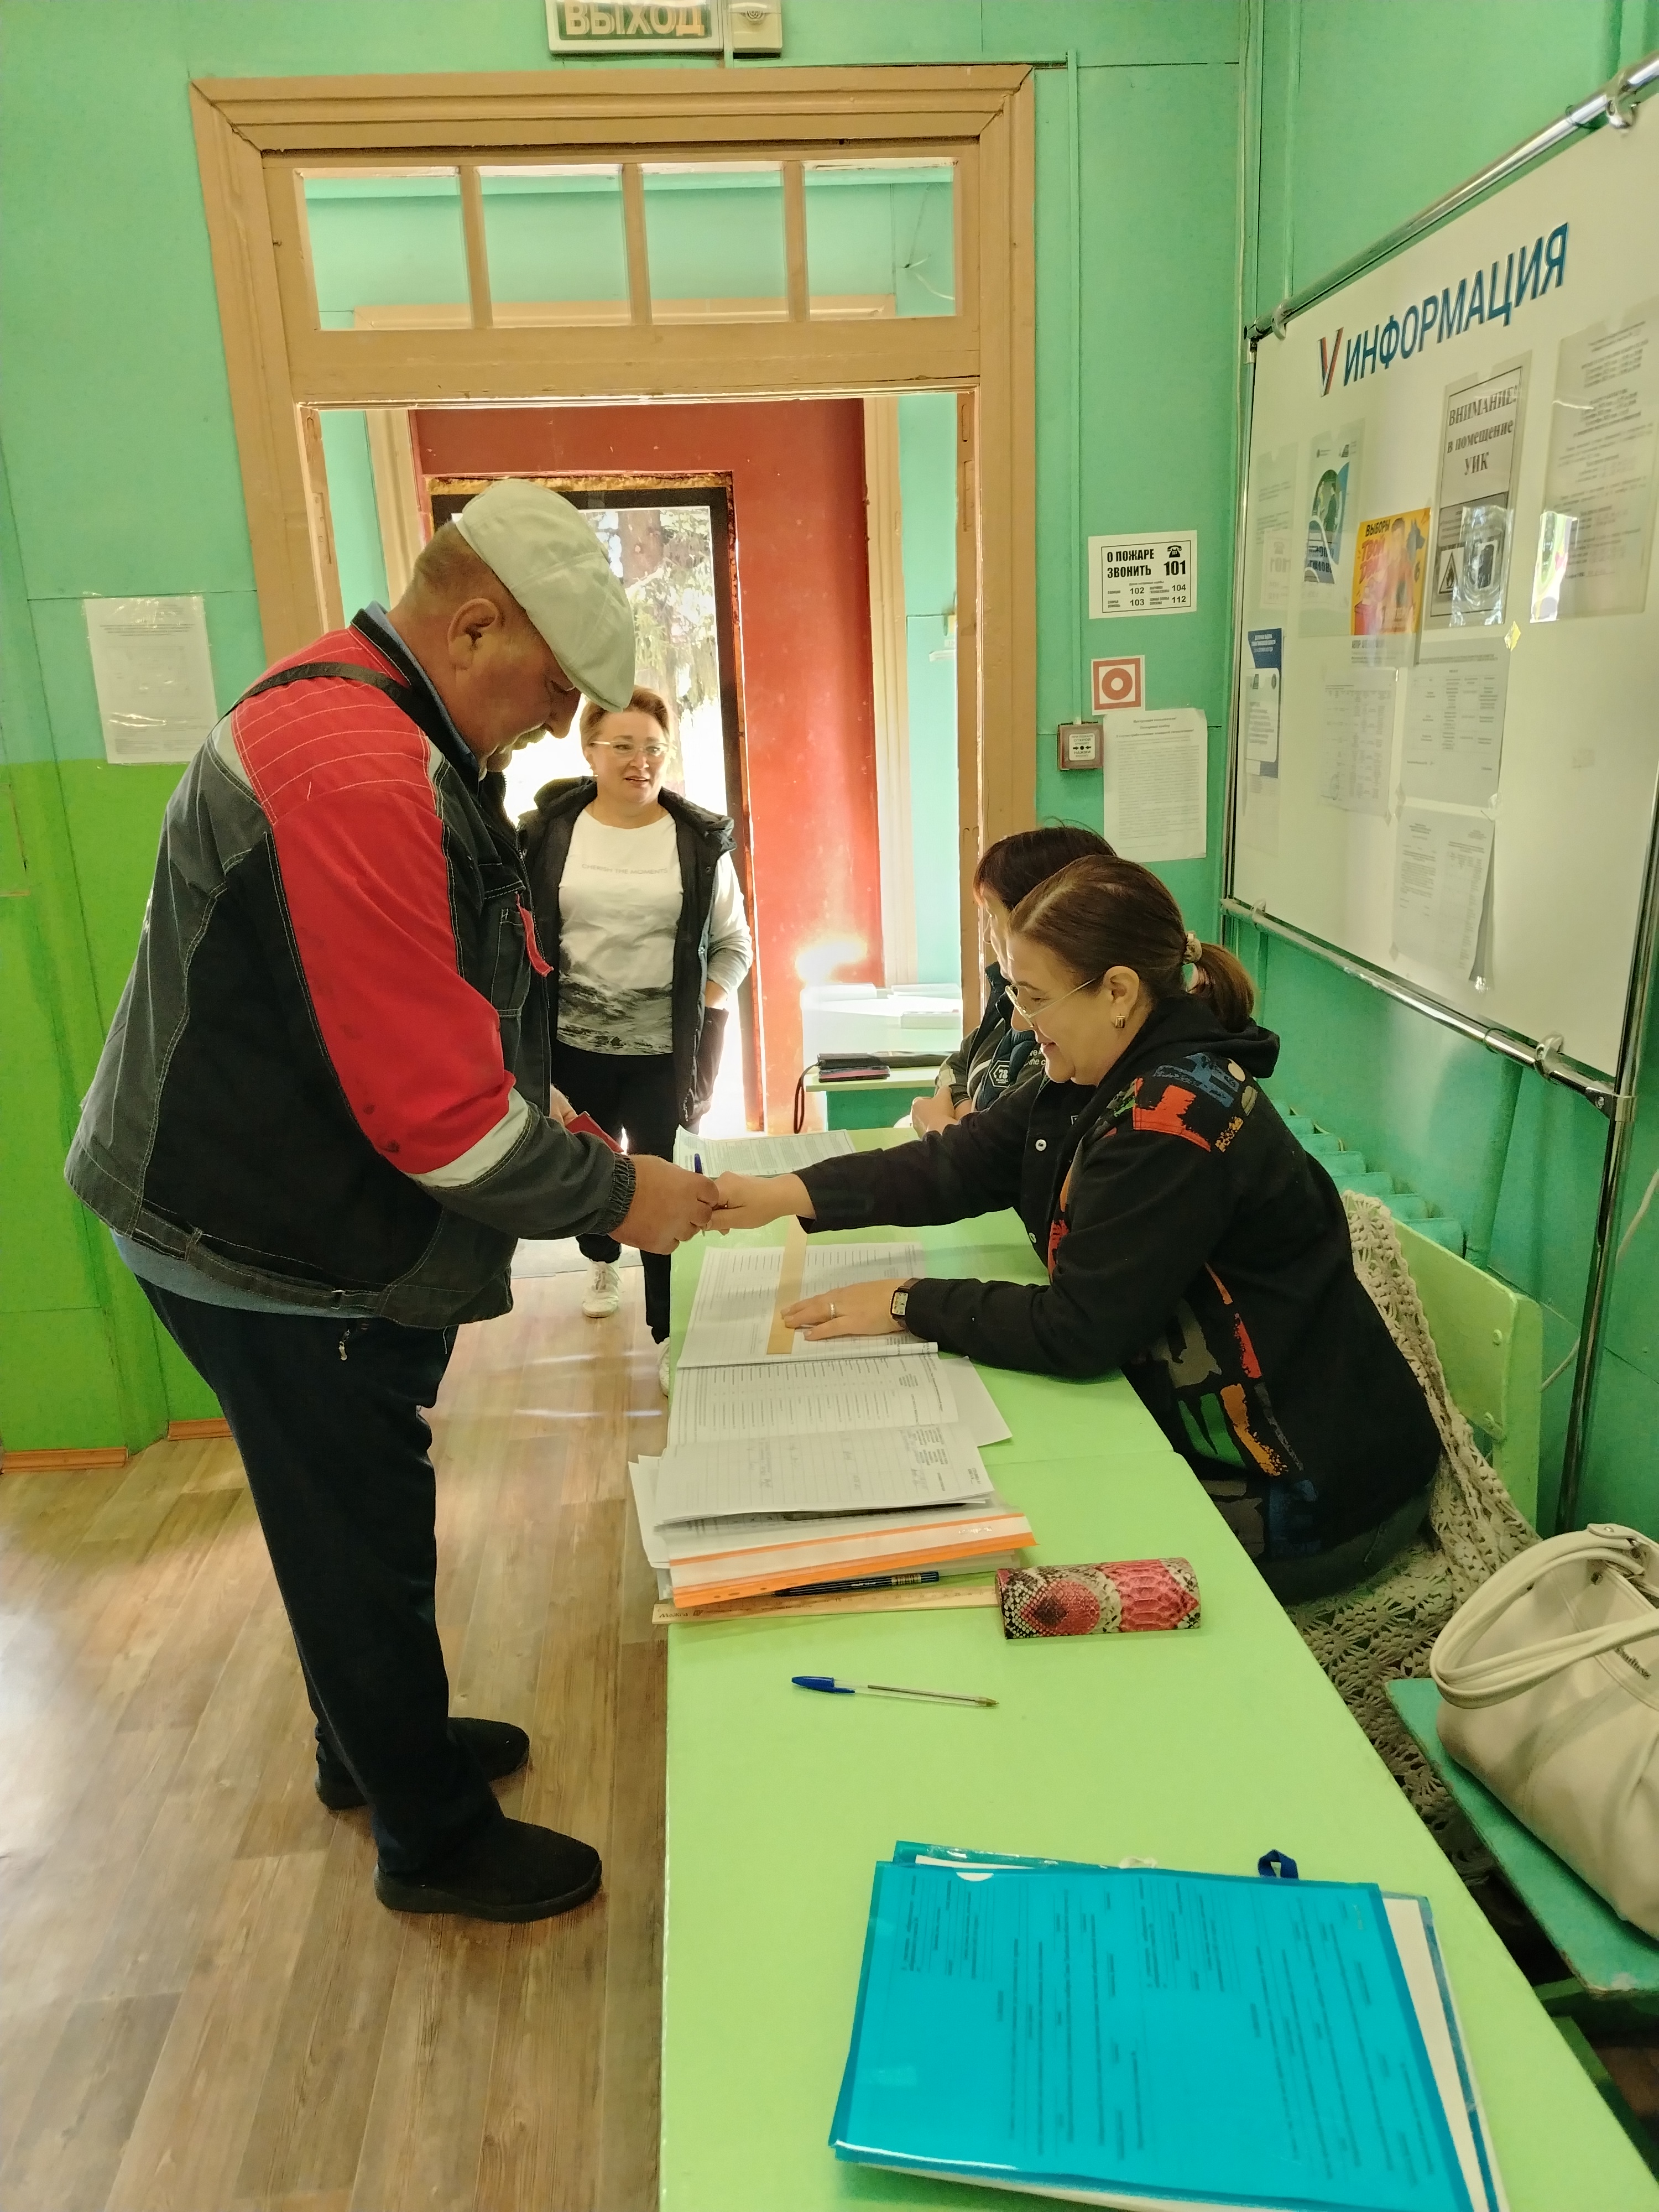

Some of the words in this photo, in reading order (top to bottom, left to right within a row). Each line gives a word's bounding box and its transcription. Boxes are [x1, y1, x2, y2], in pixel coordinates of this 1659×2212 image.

[564, 0, 705, 36] ВЫХОД
[1343, 222, 1568, 387] ИНФОРМАЦИЯ
[1448, 385, 1518, 426] ВНИМАНИЕ!
[1447, 441, 1453, 453] в
[1455, 420, 1514, 451] помещение
[1464, 451, 1490, 475] УИК
[1107, 552, 1113, 562] О
[1116, 549, 1154, 561] ПОЖАРЕ
[1107, 565, 1151, 578] ЗВОНИТЬ
[1164, 560, 1186, 576] 101
[581, 863, 613, 873] CHERISH
[999, 1069, 1008, 1079] 78
